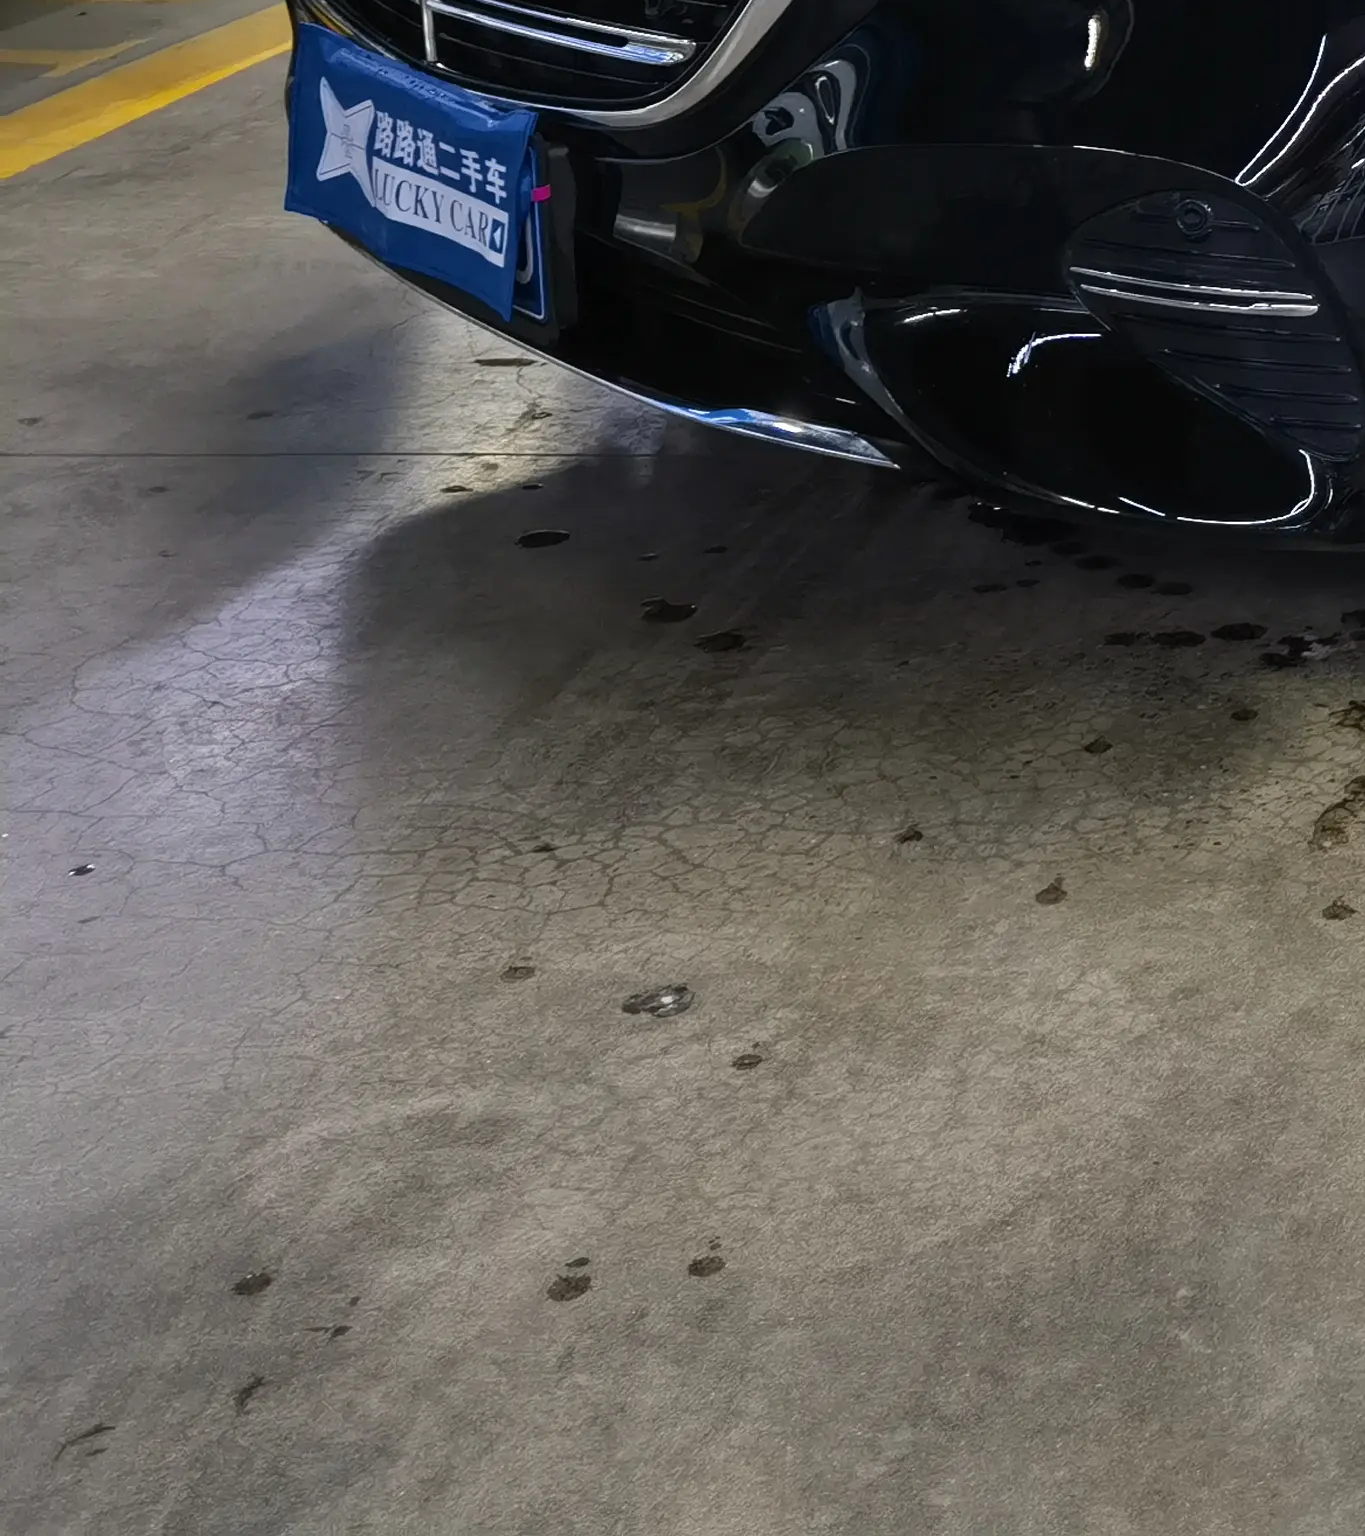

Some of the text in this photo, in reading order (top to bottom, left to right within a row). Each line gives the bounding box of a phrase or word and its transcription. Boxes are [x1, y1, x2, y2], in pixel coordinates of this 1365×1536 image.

[373, 110, 508, 205] 路路通二手车
[374, 167, 488, 248] LUCKY CAR
